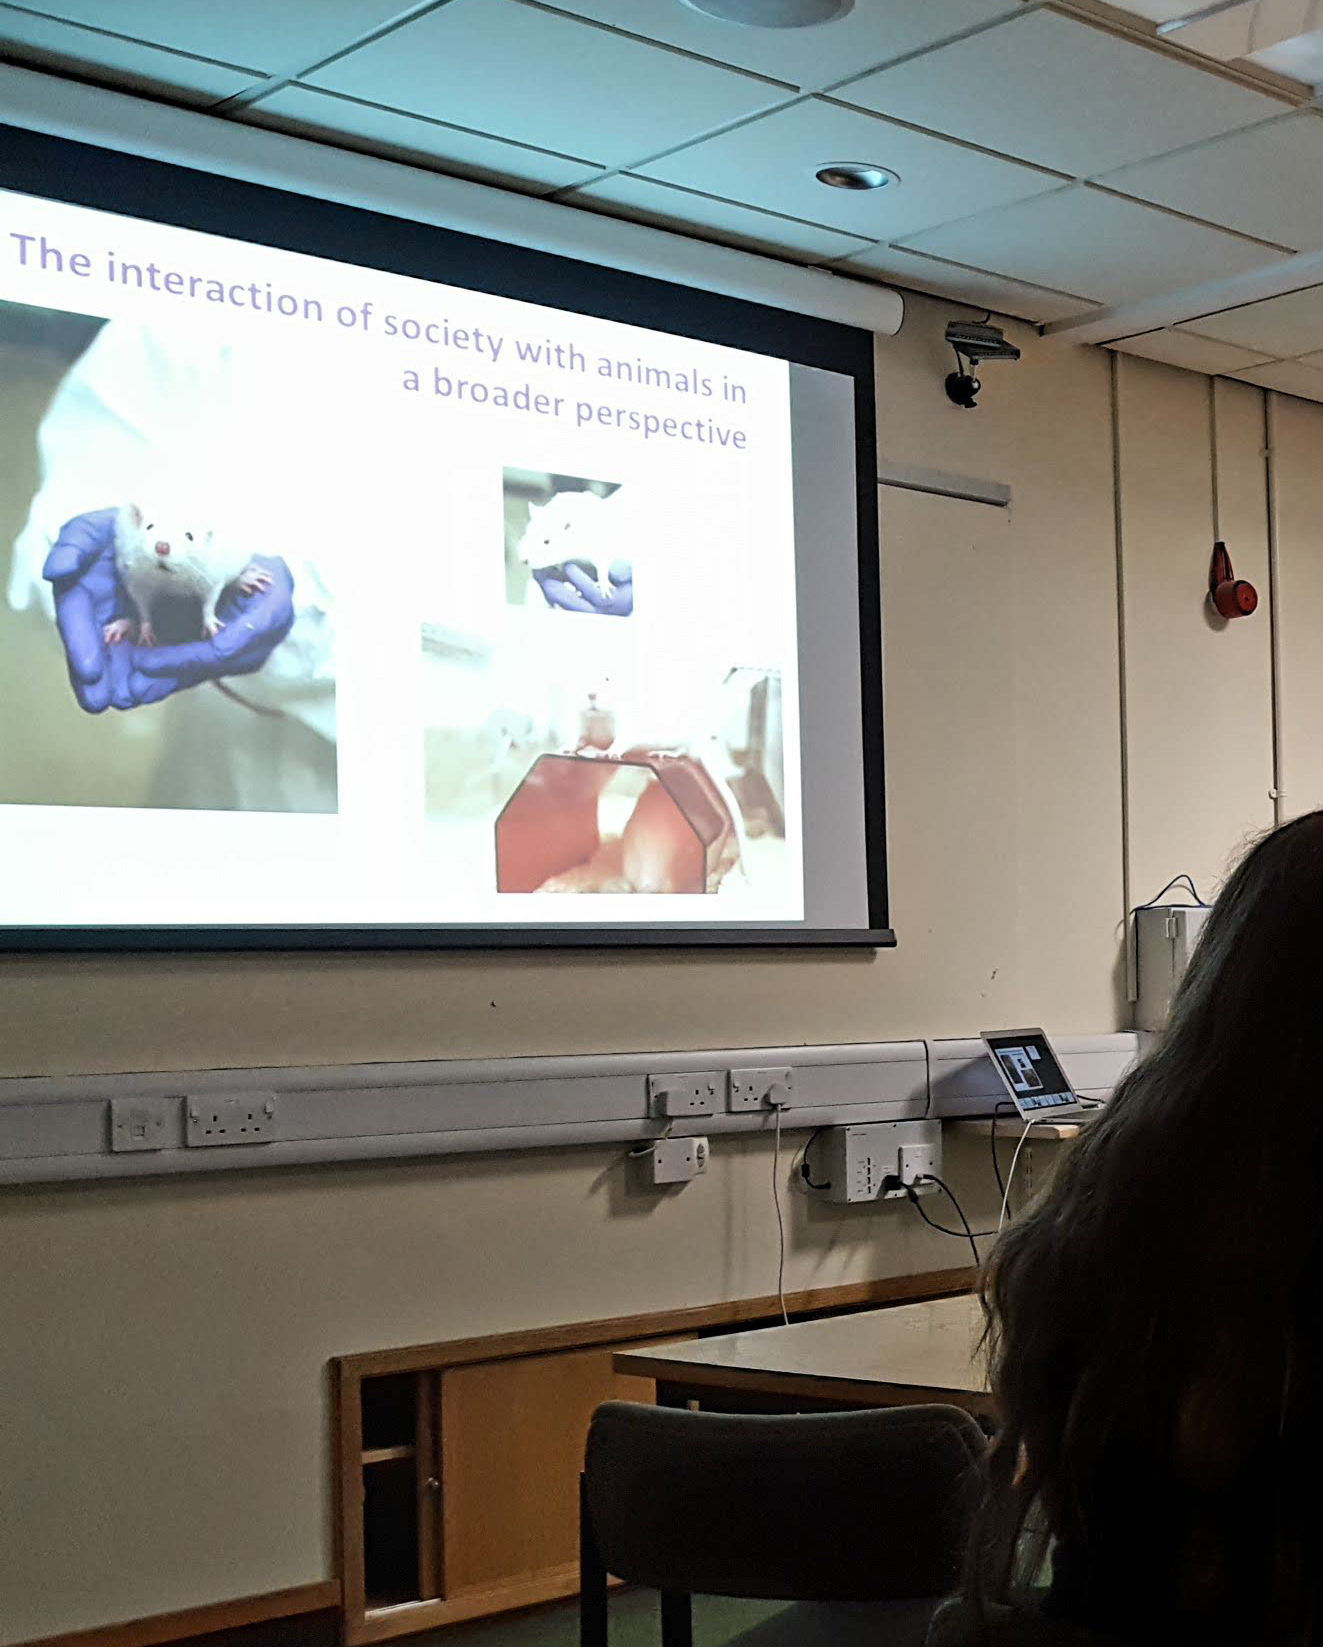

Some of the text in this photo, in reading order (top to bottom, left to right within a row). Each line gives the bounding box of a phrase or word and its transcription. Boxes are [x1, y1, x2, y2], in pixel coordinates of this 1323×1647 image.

[10, 232, 747, 404] The interaction of society with animals in
[403, 367, 747, 449] a broader perspective
